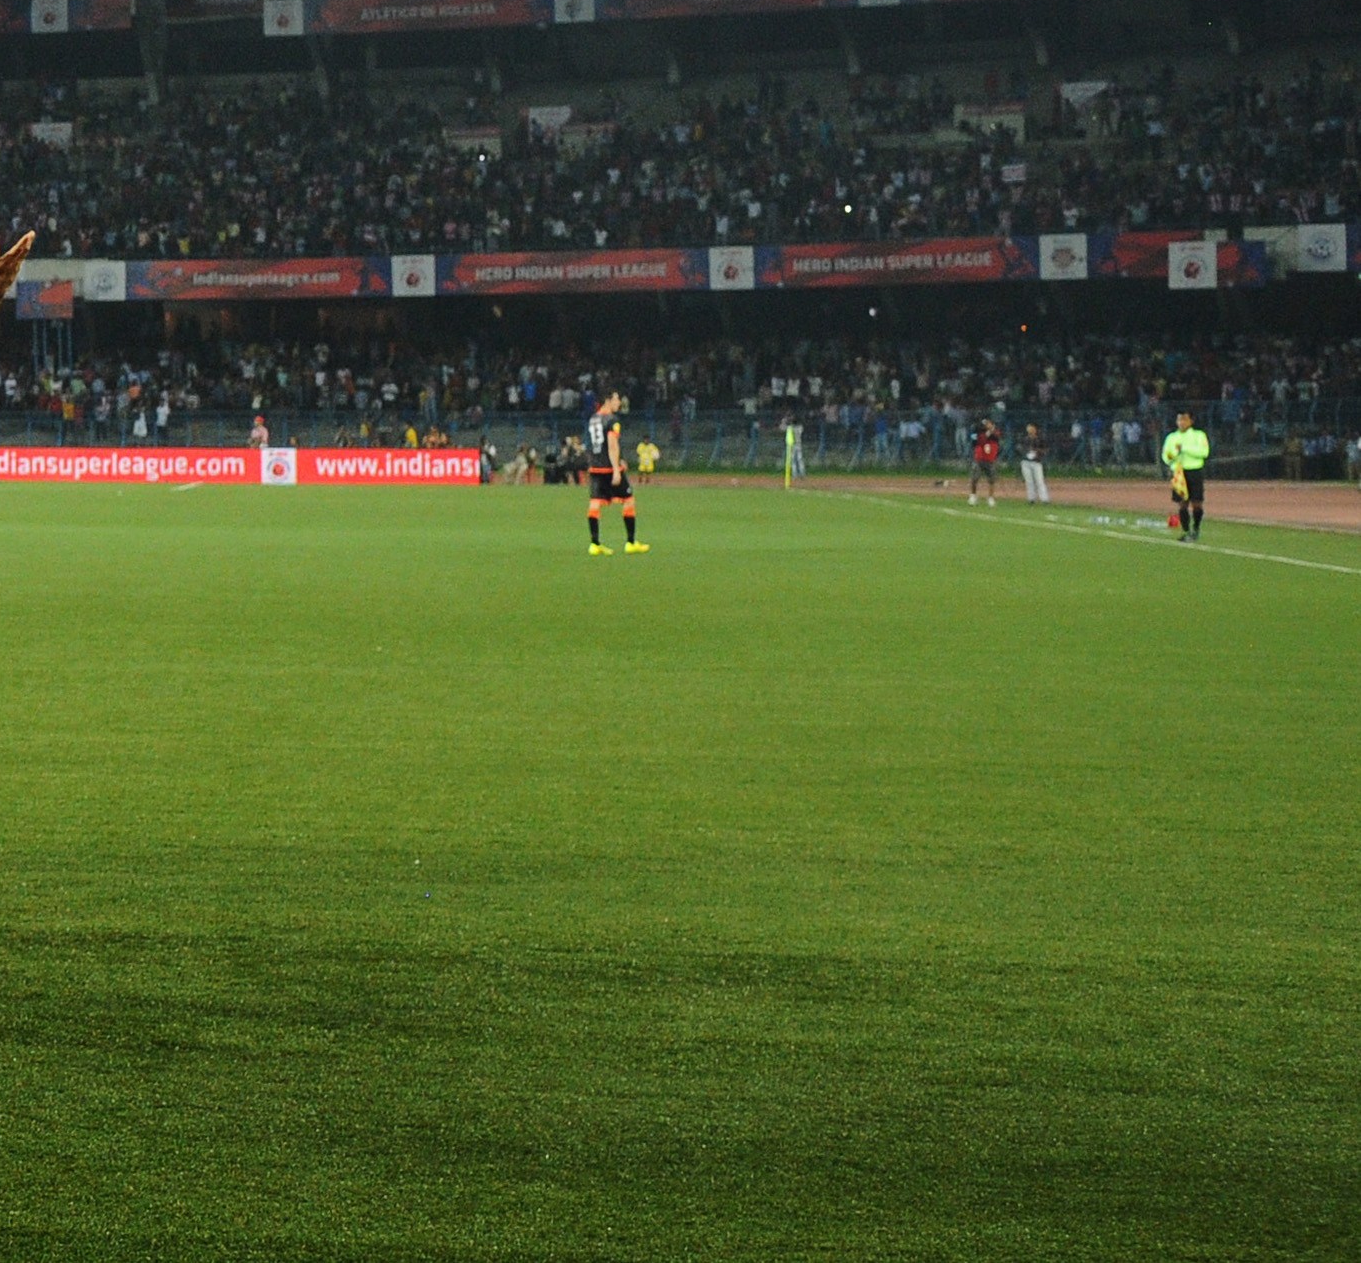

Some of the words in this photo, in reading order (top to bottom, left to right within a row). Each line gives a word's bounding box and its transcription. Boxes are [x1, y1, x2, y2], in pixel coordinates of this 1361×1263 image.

[475, 268, 512, 281] HERO
[515, 266, 564, 280] INDIAN
[566, 265, 610, 278] SUPER
[613, 263, 667, 277] LEAGUE
[793, 258, 832, 273] HERO
[835, 256, 884, 271] INDIAN
[887, 254, 934, 269] SUPER
[936, 251, 992, 266] LEAGUE
